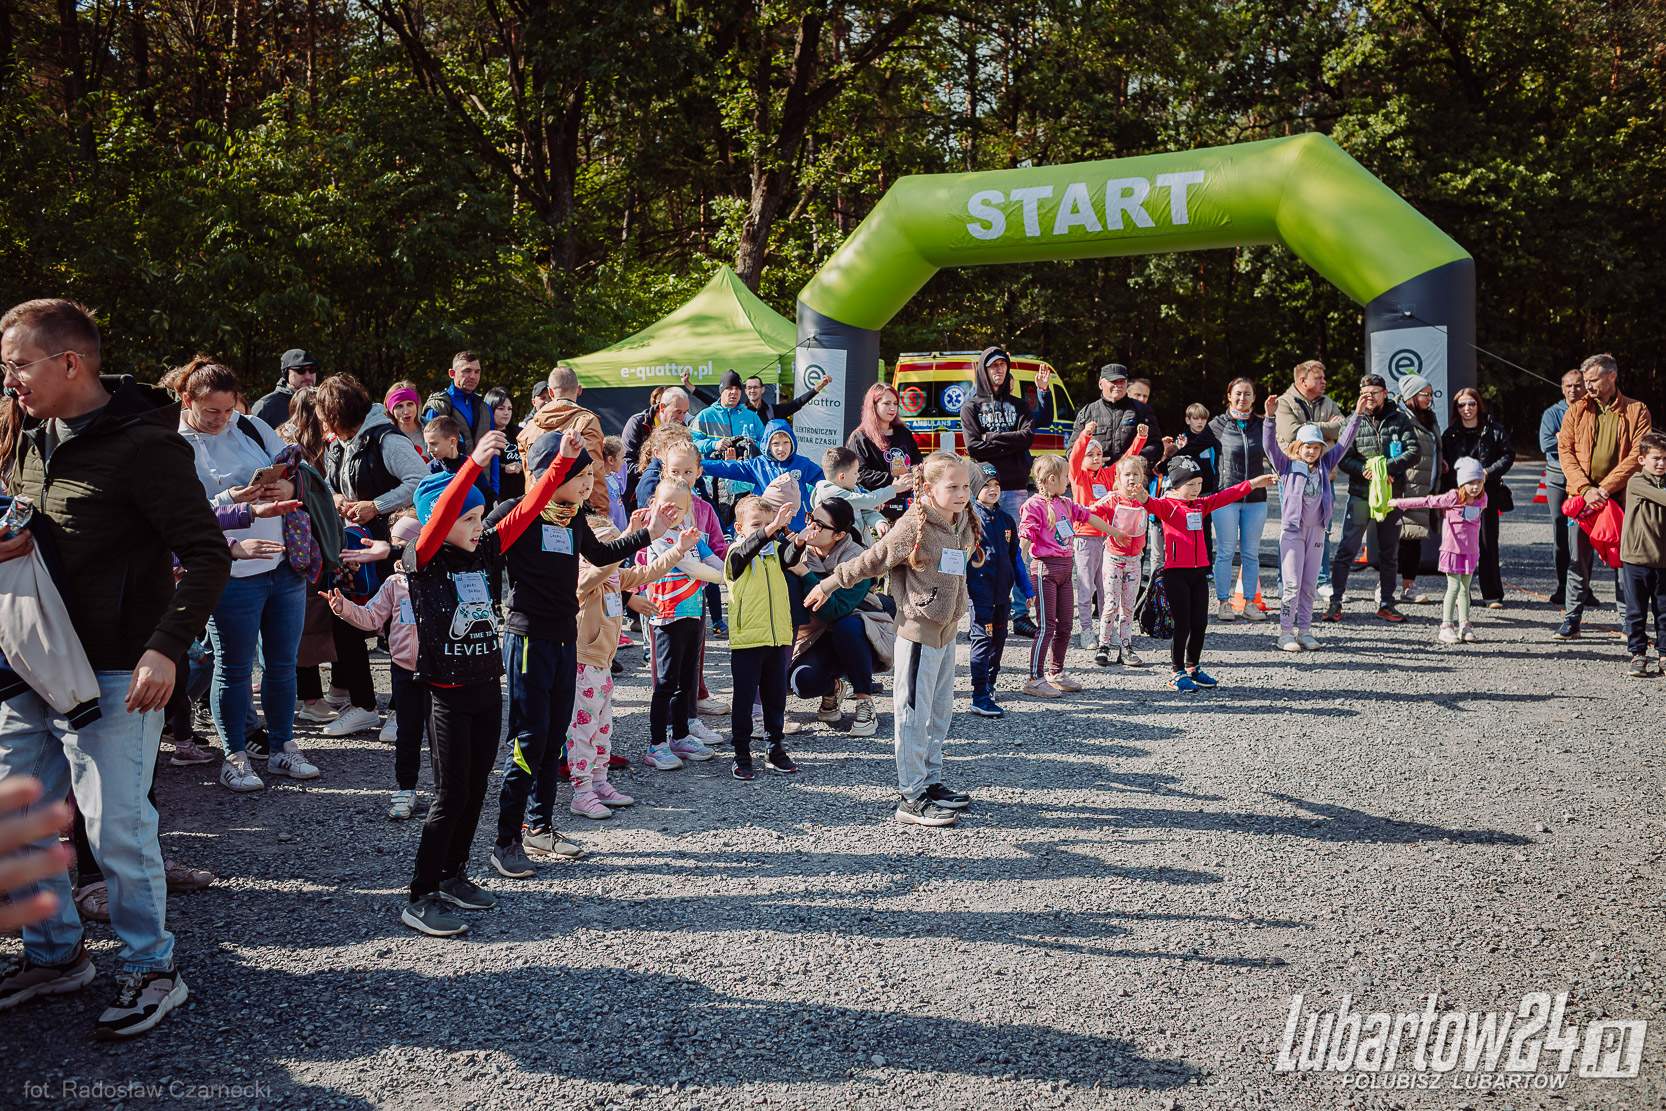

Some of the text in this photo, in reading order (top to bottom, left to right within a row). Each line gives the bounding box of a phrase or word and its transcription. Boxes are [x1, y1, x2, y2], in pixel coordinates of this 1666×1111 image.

[966, 170, 1205, 240] START
[620, 360, 713, 382] e-quattro.pl
[807, 398, 841, 408] uattro
[814, 437, 837, 446] CZASU
[470, 631, 484, 640] TIME
[444, 642, 490, 656] LEVEL
